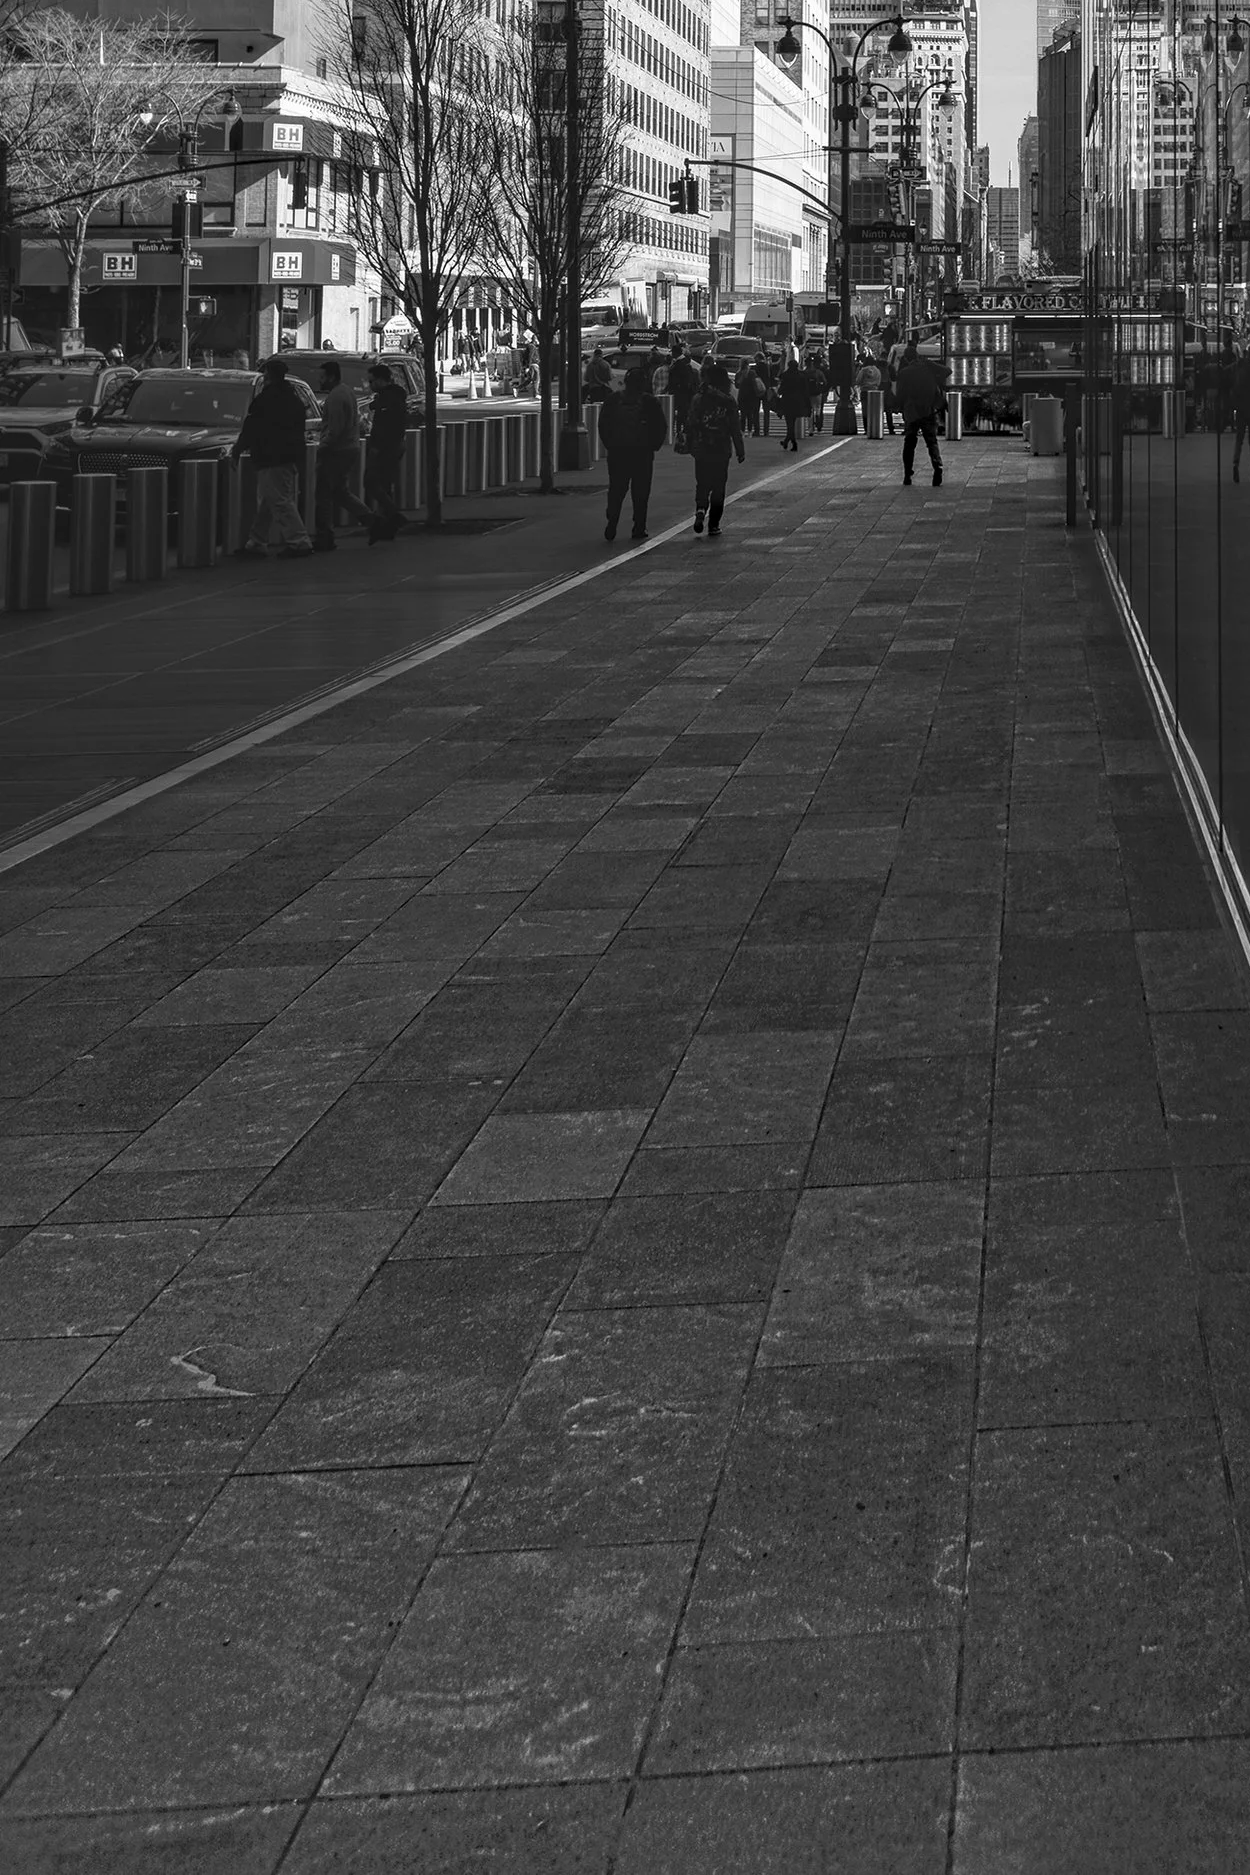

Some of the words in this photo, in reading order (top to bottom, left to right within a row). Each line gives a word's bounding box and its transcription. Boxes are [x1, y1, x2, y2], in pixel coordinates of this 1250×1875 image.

[861, 228, 888, 239] Ninth
[889, 228, 908, 239] Ave
[138, 243, 159, 252] Ninth
[920, 244, 940, 253] Ninth
[941, 245, 957, 253] Ave
[981, 295, 1066, 310] FLAVORED
